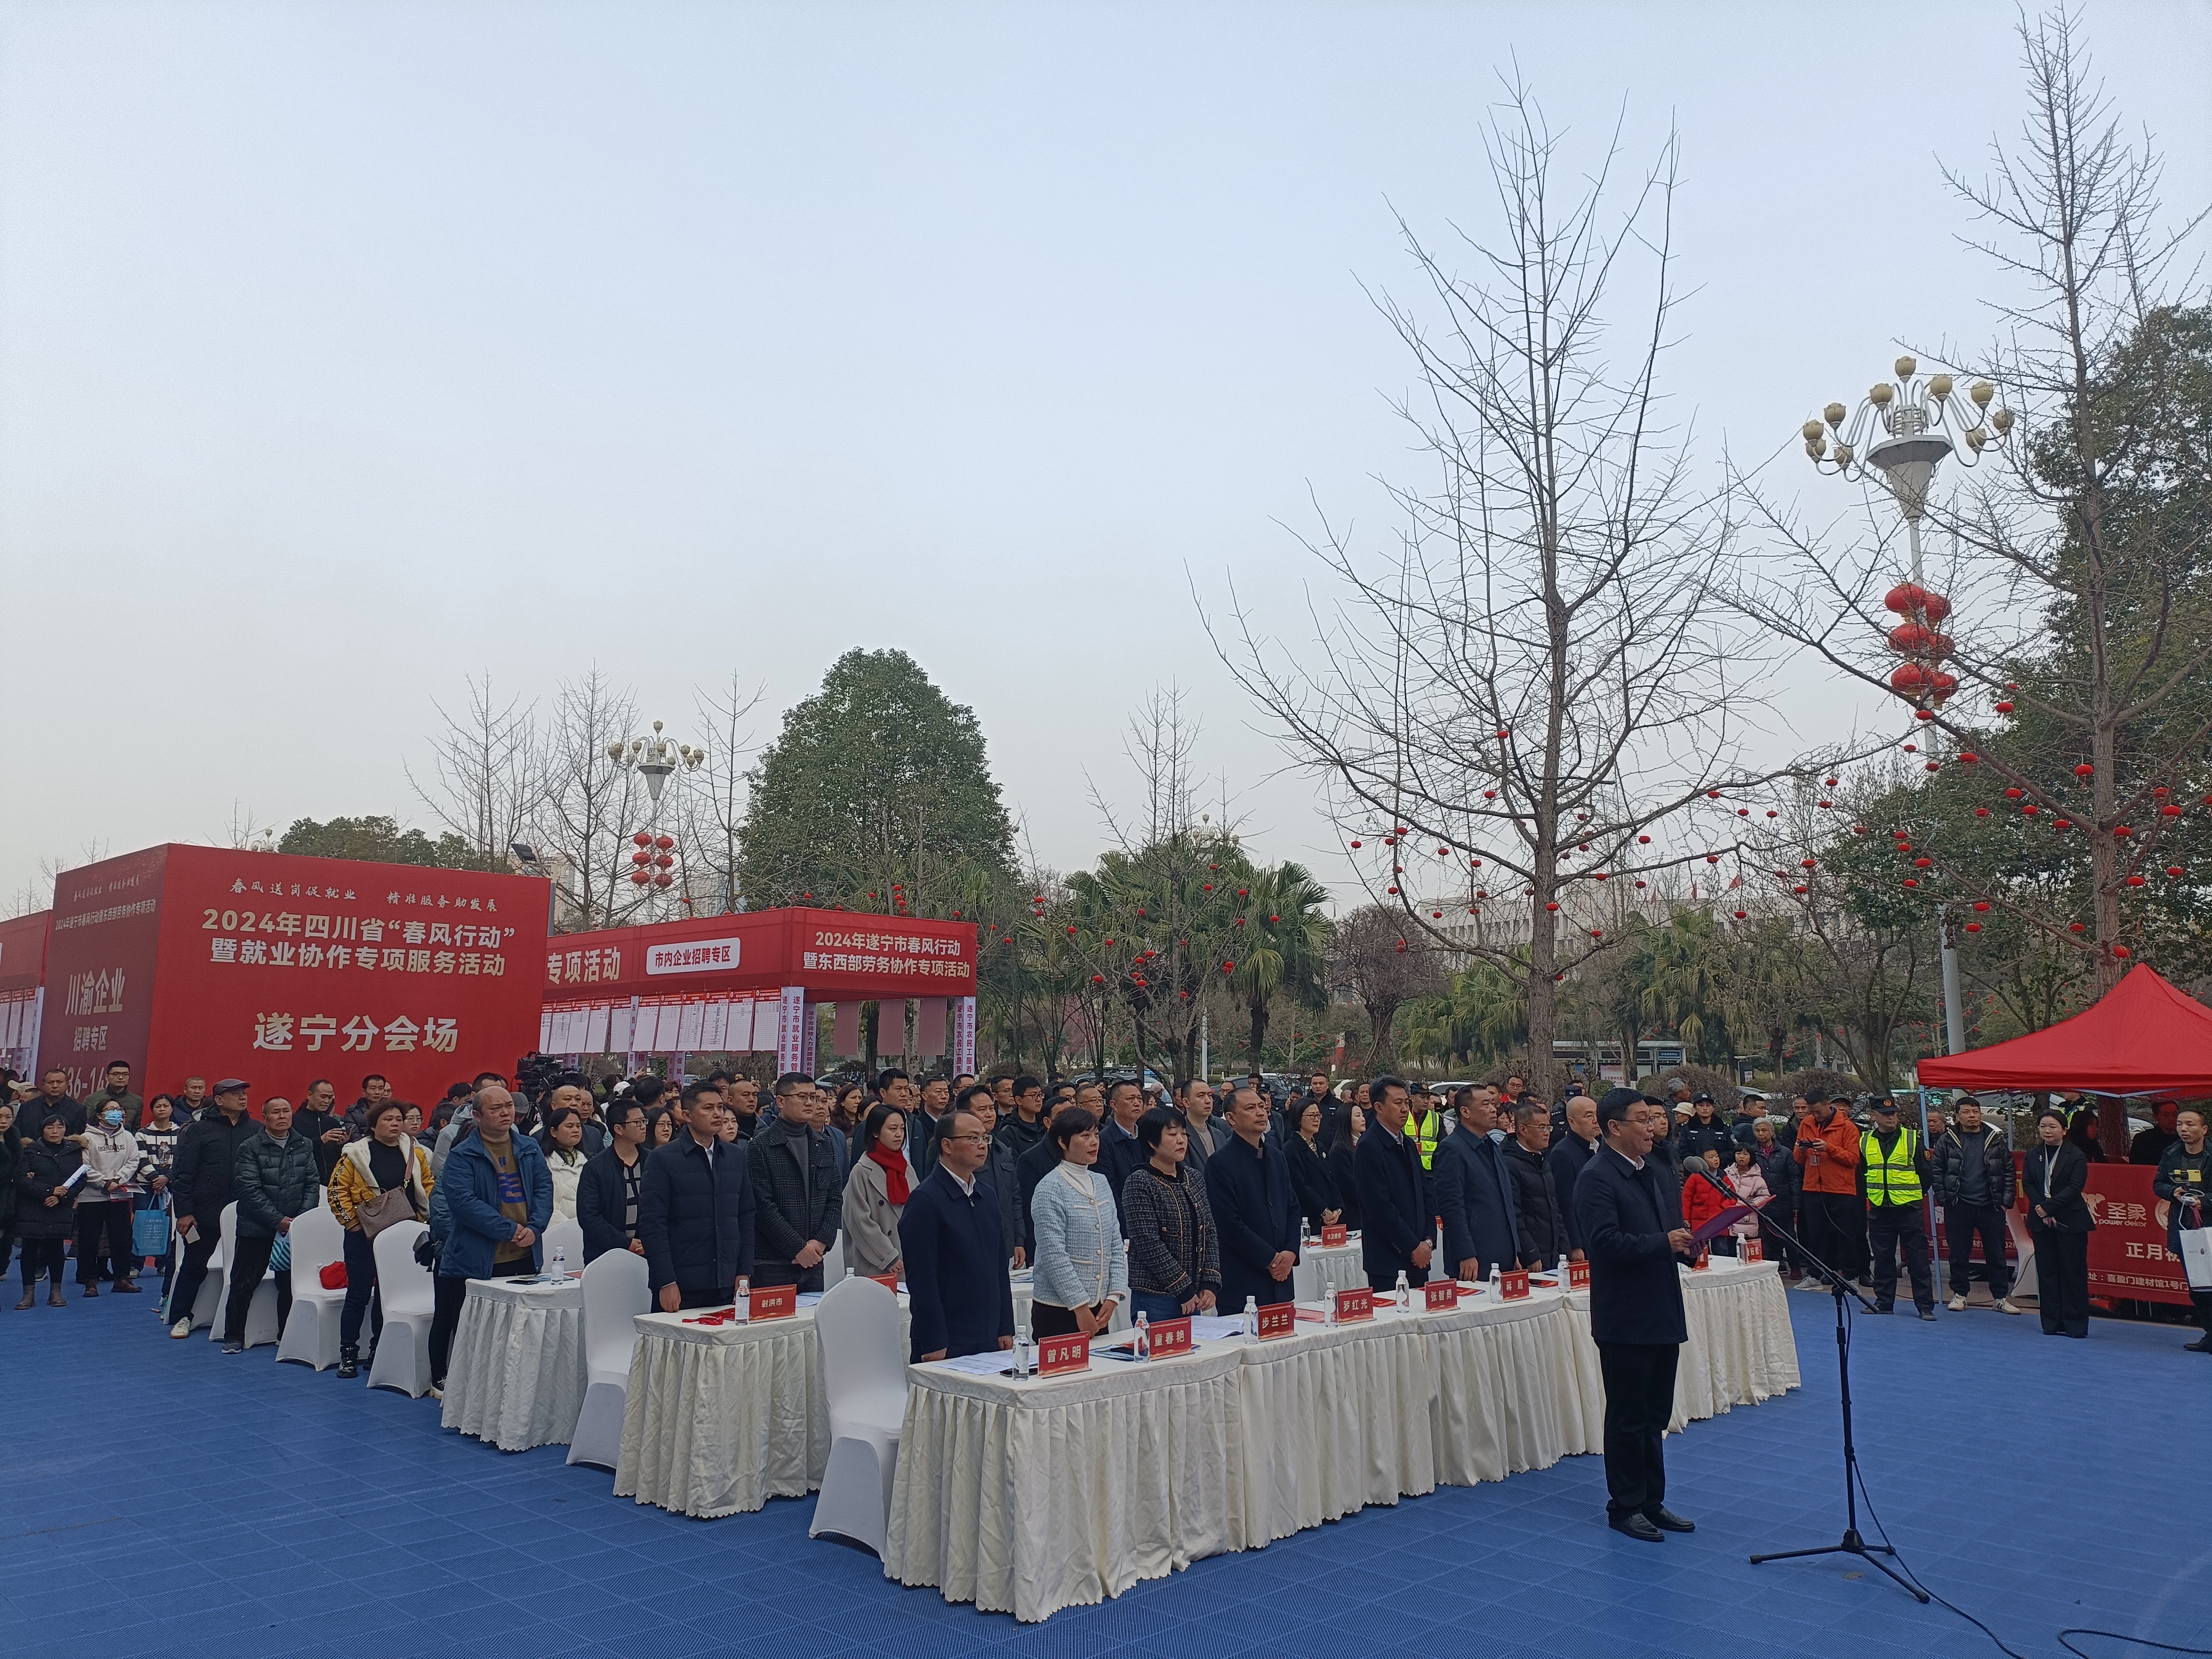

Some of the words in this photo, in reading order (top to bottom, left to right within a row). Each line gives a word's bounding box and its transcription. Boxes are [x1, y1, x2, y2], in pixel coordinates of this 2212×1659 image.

[229, 877, 357, 900] 春风送岗促就业
[386, 892, 499, 913] 精准服务助发展
[201, 908, 516, 949] 2024年四川省“春风行动”
[210, 938, 505, 976] 暨就业协作专项服务活动
[815, 930, 961, 957] 2024年遂宁市春风行动
[547, 946, 621, 984] 专项活动
[654, 947, 731, 968] 市内企业招聘专区
[803, 951, 971, 979] 暨东西部劳务协作专项活动
[65, 967, 126, 1017] 川渝企业
[73, 1025, 109, 1052] 招聘专区
[253, 1012, 459, 1052] 遂宁分会场
[2107, 1202, 2146, 1220] 圣象
[761, 1297, 783, 1308] 射洪市
[1343, 1298, 1368, 1312] 罗红光
[1430, 1289, 1452, 1302] 张智勇
[1262, 1313, 1288, 1329] 步兰兰
[1154, 1329, 1185, 1347] 童春艳
[1047, 1345, 1082, 1363] 曾凡明
